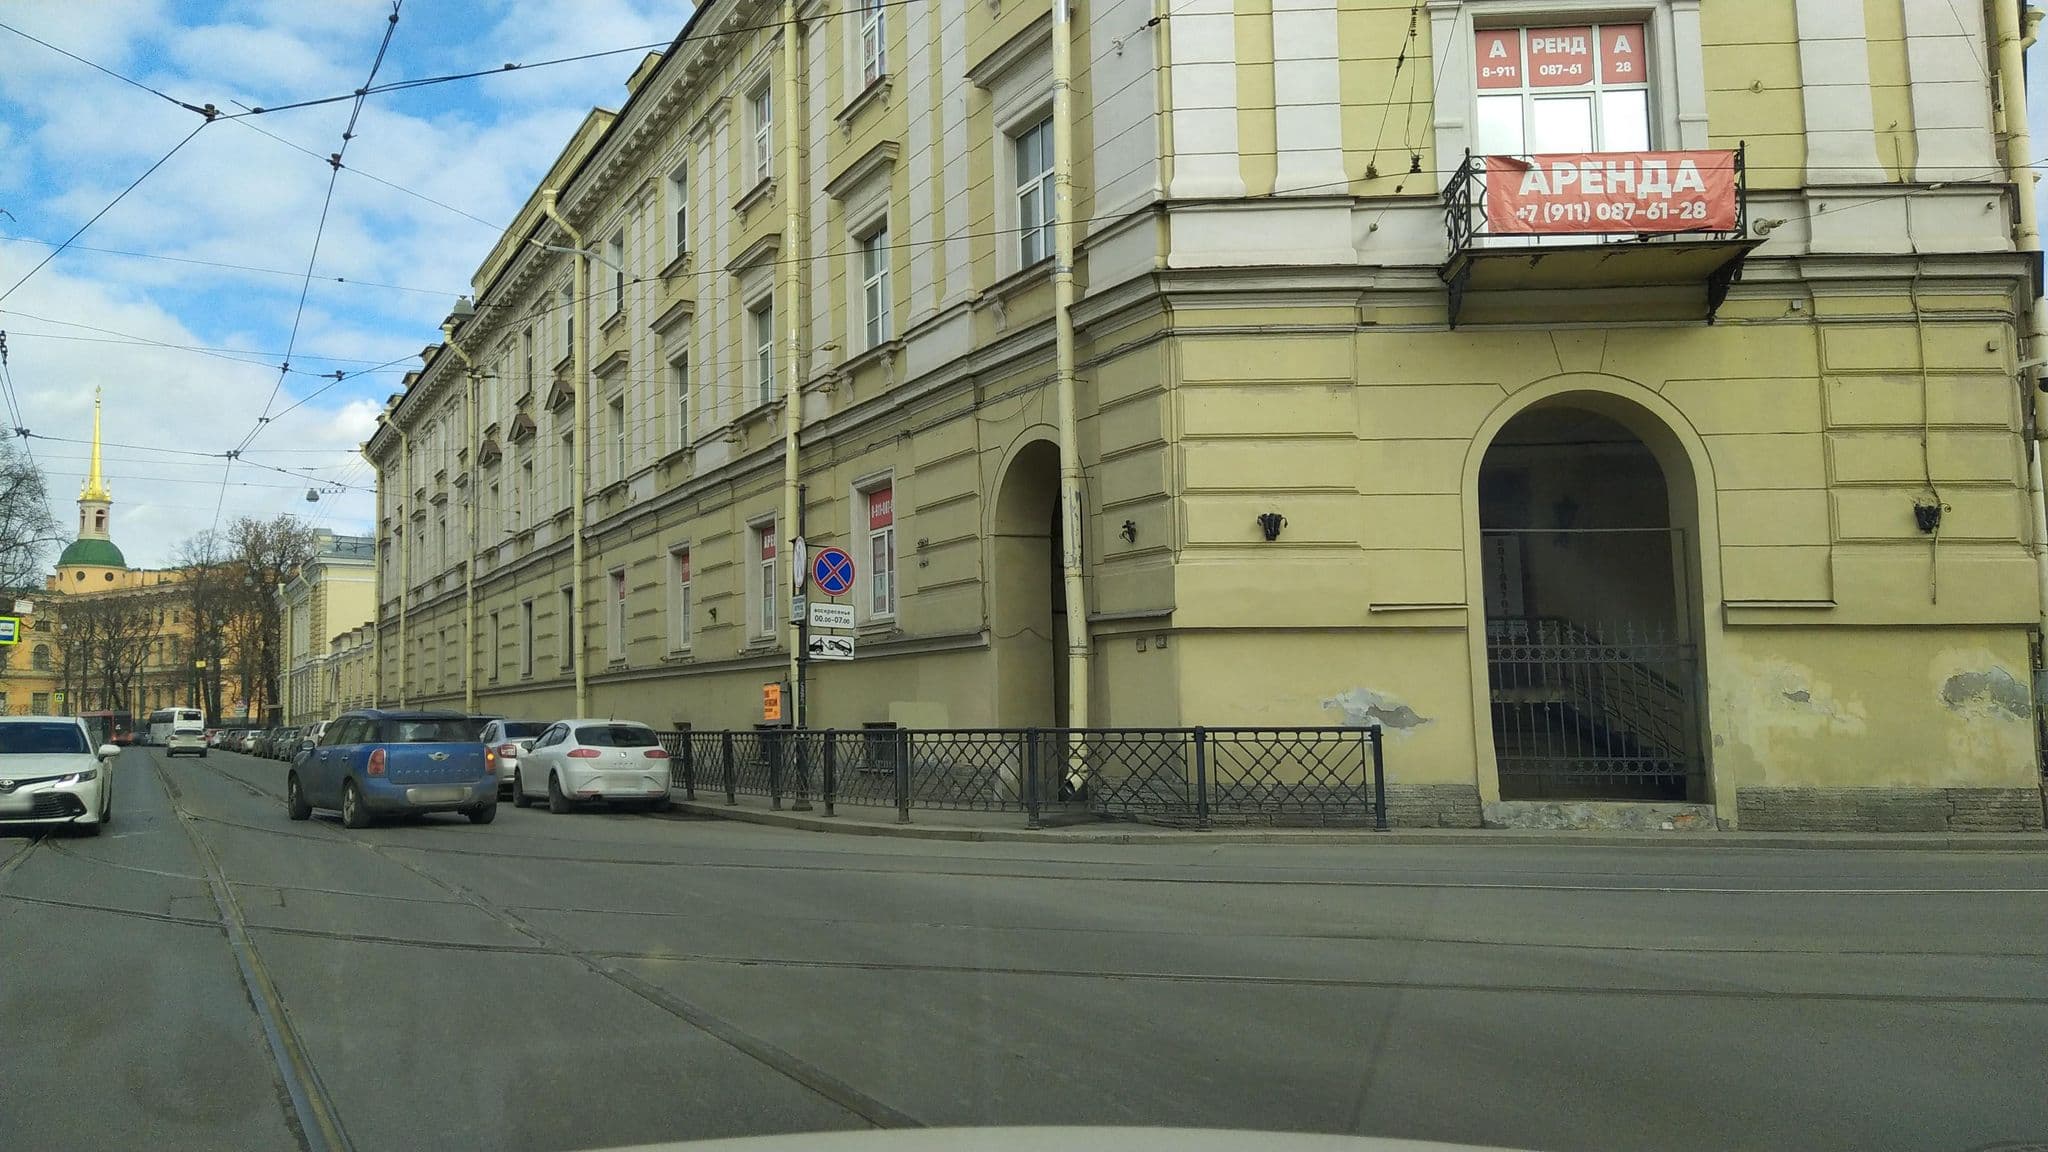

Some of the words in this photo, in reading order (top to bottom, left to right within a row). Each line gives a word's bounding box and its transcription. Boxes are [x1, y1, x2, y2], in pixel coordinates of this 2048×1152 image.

[1489, 39, 1507, 58] А
[1532, 36, 1587, 55] РЕНД
[1613, 35, 1632, 53] А
[1482, 66, 1515, 77] 8-911
[1539, 64, 1582, 75] 087-61
[1615, 62, 1632, 73] 28
[1518, 159, 1706, 199] АРЕНДА
[1516, 203, 1537, 223] +7
[1544, 201, 1591, 223] (911)
[1596, 201, 1707, 221] 087-61-28
